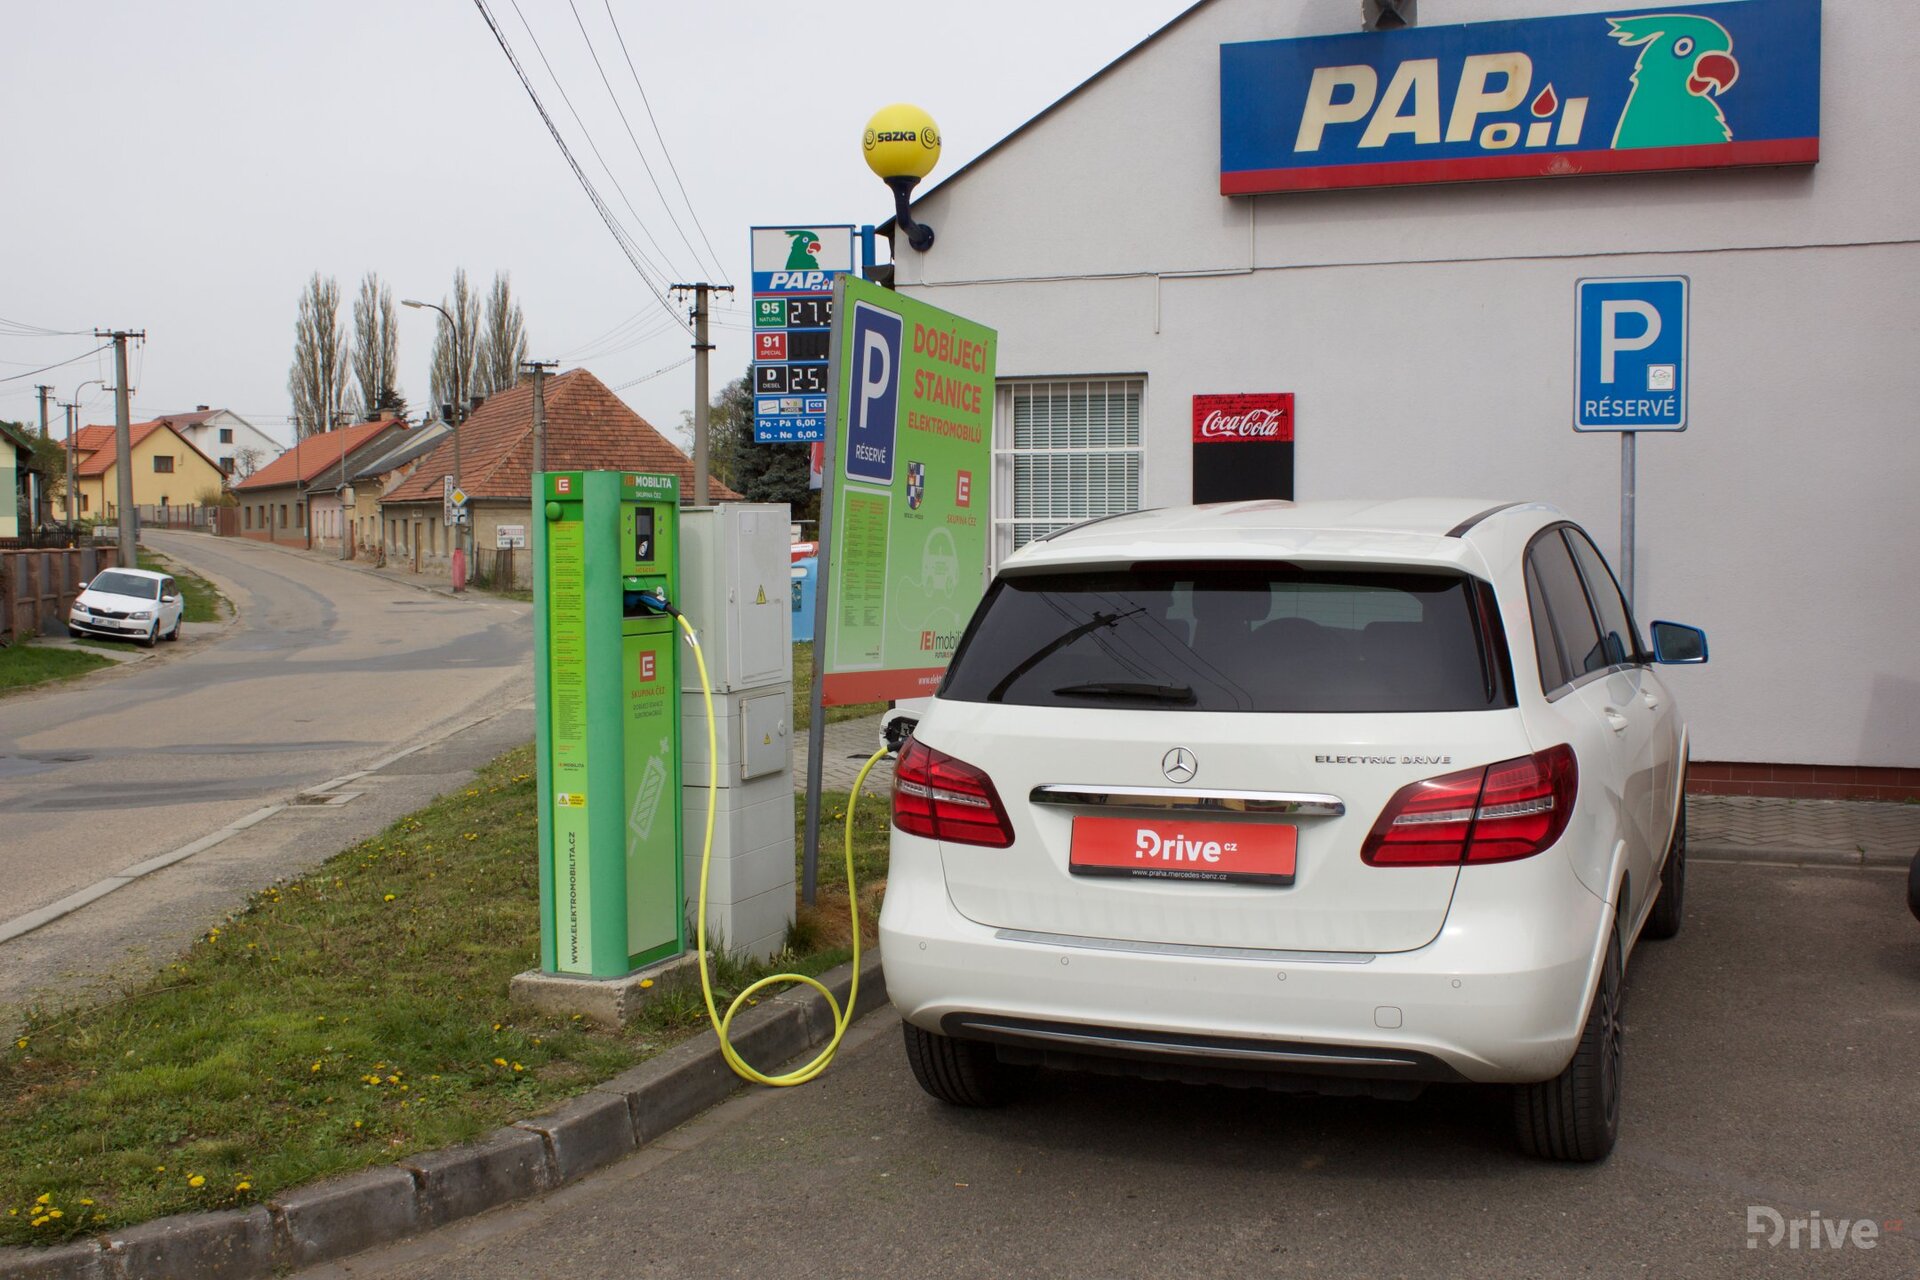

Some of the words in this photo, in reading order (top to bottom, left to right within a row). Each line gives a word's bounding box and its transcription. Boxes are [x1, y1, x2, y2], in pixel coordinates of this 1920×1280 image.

[761, 302, 780, 314] 95
[763, 335, 780, 347] 91
[913, 323, 988, 374] DOBÍJECÍ
[1600, 299, 1662, 384] P
[766, 369, 777, 381] D
[859, 329, 891, 429] P
[913, 368, 982, 414] STANICE
[1585, 395, 1676, 417] RÉSERVÉ
[760, 420, 772, 428] Po
[796, 419, 816, 428] 6,00
[1202, 408, 1285, 437] Coca-Cola
[760, 431, 772, 439] So
[780, 431, 793, 439] Ne
[797, 431, 818, 440] 6,00
[856, 443, 887, 464] RÉSERVÉ
[1315, 755, 1396, 765] ELECTRIC
[1400, 756, 1452, 765] DRIVE
[1135, 829, 1221, 863] Drive
[1132, 869, 1227, 880] www.praha.mercedes-benz.cz
[568, 831, 578, 965] WWW.ELEKTROMOBILITA.CZ
